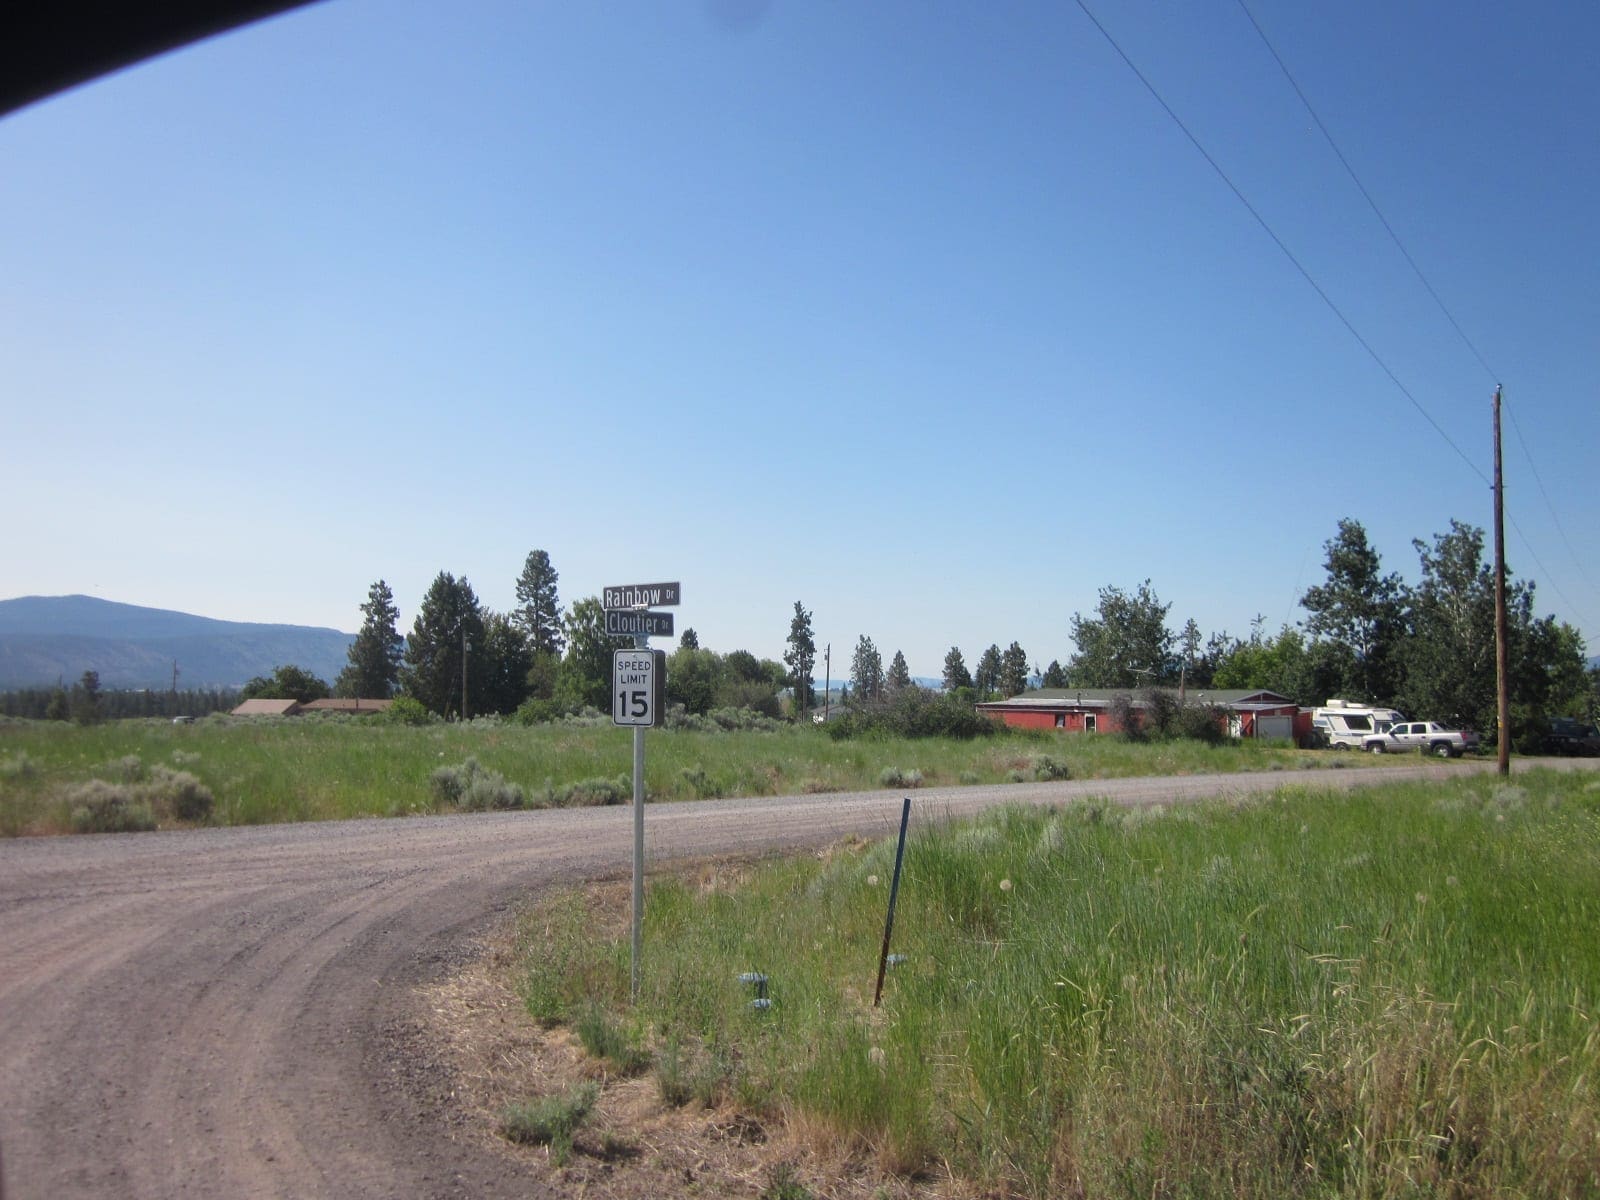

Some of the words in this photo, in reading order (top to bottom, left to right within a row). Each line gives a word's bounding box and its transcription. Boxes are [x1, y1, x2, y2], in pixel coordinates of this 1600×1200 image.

[606, 587, 660, 607] Rainbow
[609, 612, 657, 633] Cloutier
[618, 661, 651, 671] SPEED
[621, 674, 647, 684] LIMIT
[619, 691, 648, 717] 15
